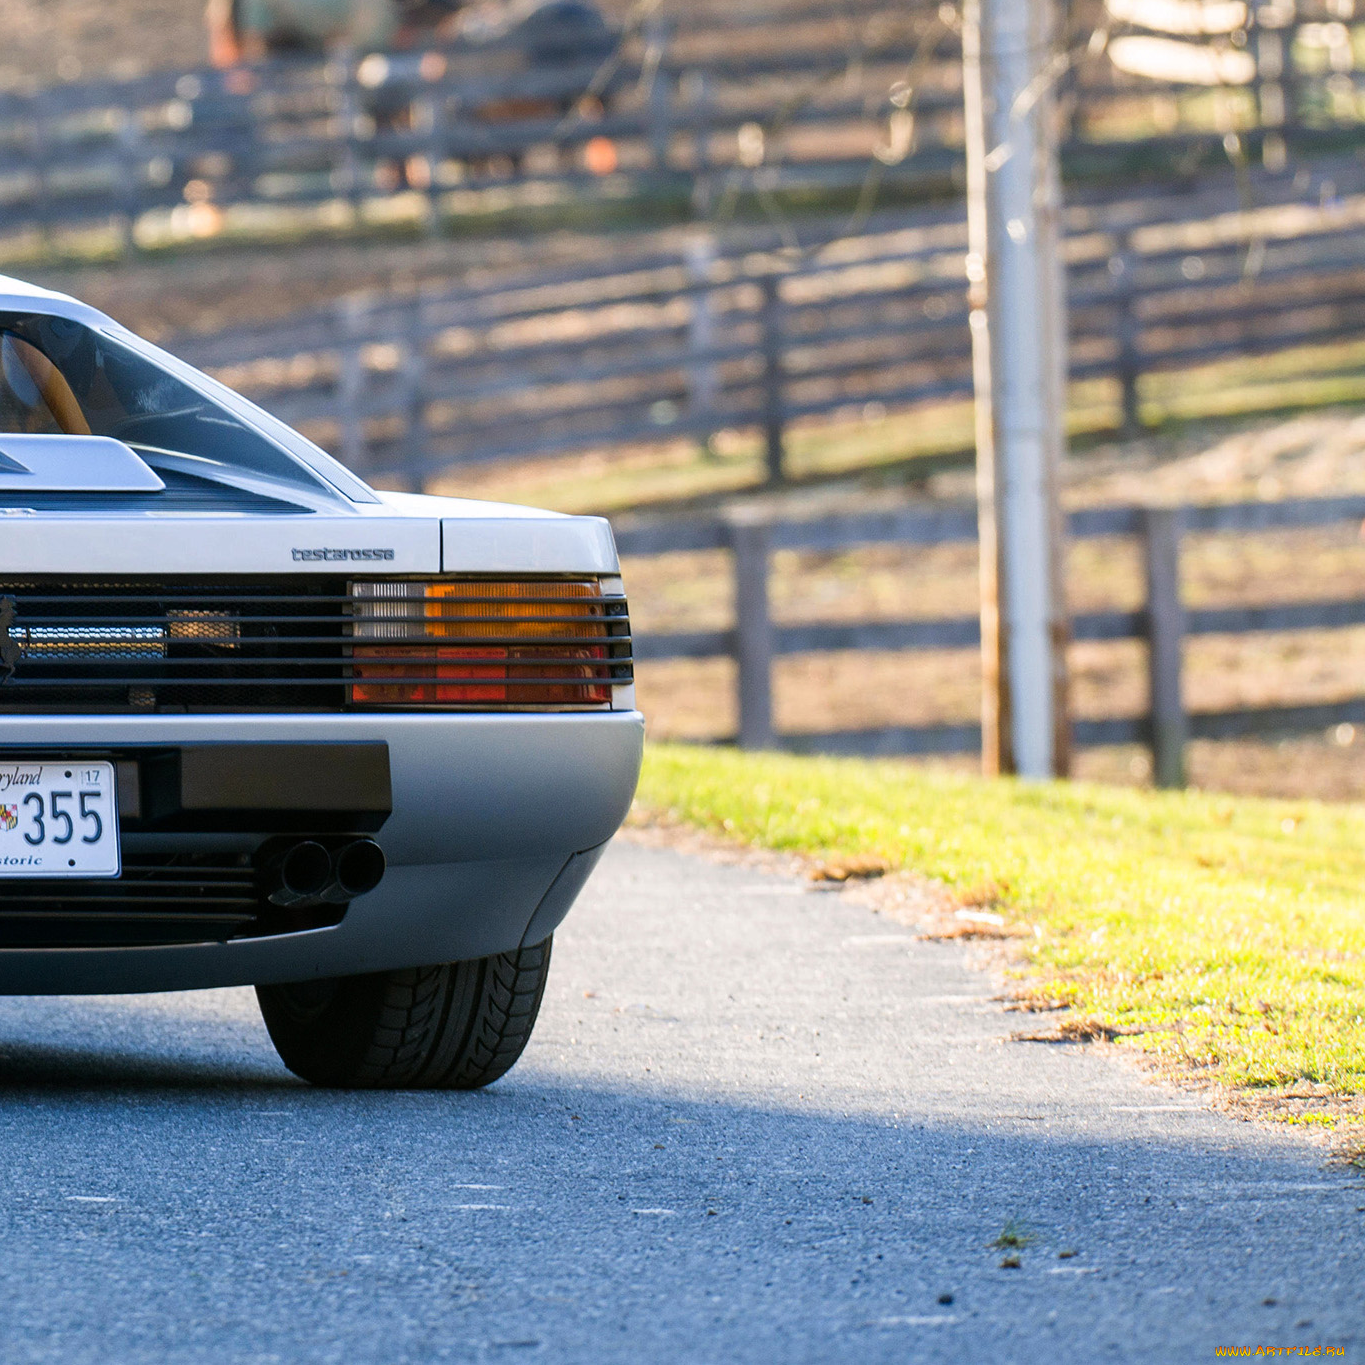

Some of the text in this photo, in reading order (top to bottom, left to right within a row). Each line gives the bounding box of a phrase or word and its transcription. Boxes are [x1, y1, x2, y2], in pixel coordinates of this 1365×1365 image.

[291, 547, 395, 561] testarossa
[85, 770, 100, 782] 17
[23, 790, 103, 845] 355
